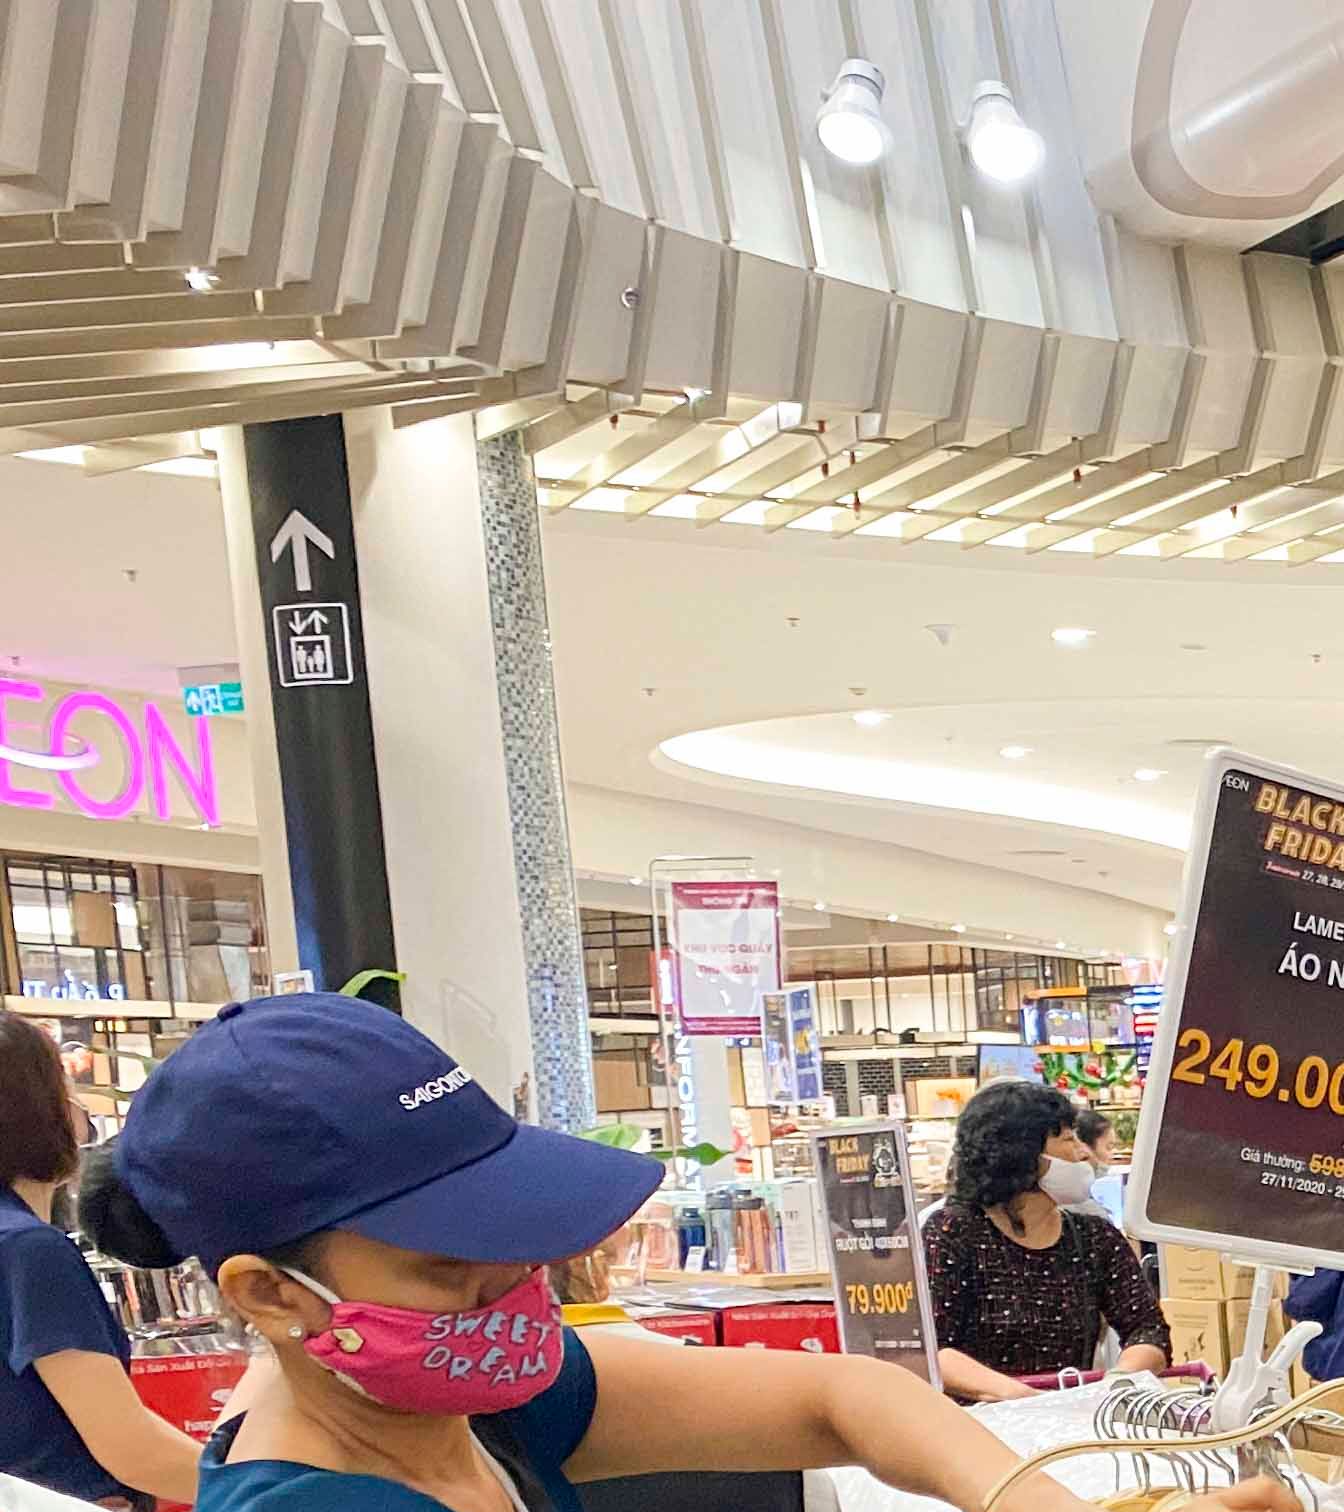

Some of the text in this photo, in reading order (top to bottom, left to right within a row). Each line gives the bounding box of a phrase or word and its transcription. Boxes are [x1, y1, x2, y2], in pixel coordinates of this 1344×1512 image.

[0, 677, 221, 828] EON
[1278, 942, 1322, 983] ÁO
[1240, 1147, 1262, 1164] Giá
[1261, 1171, 1326, 1196] 27/11/2020
[845, 1281, 914, 1315] 79.900đ
[424, 1311, 550, 1349] SWEET
[423, 1345, 548, 1387] DREAM
